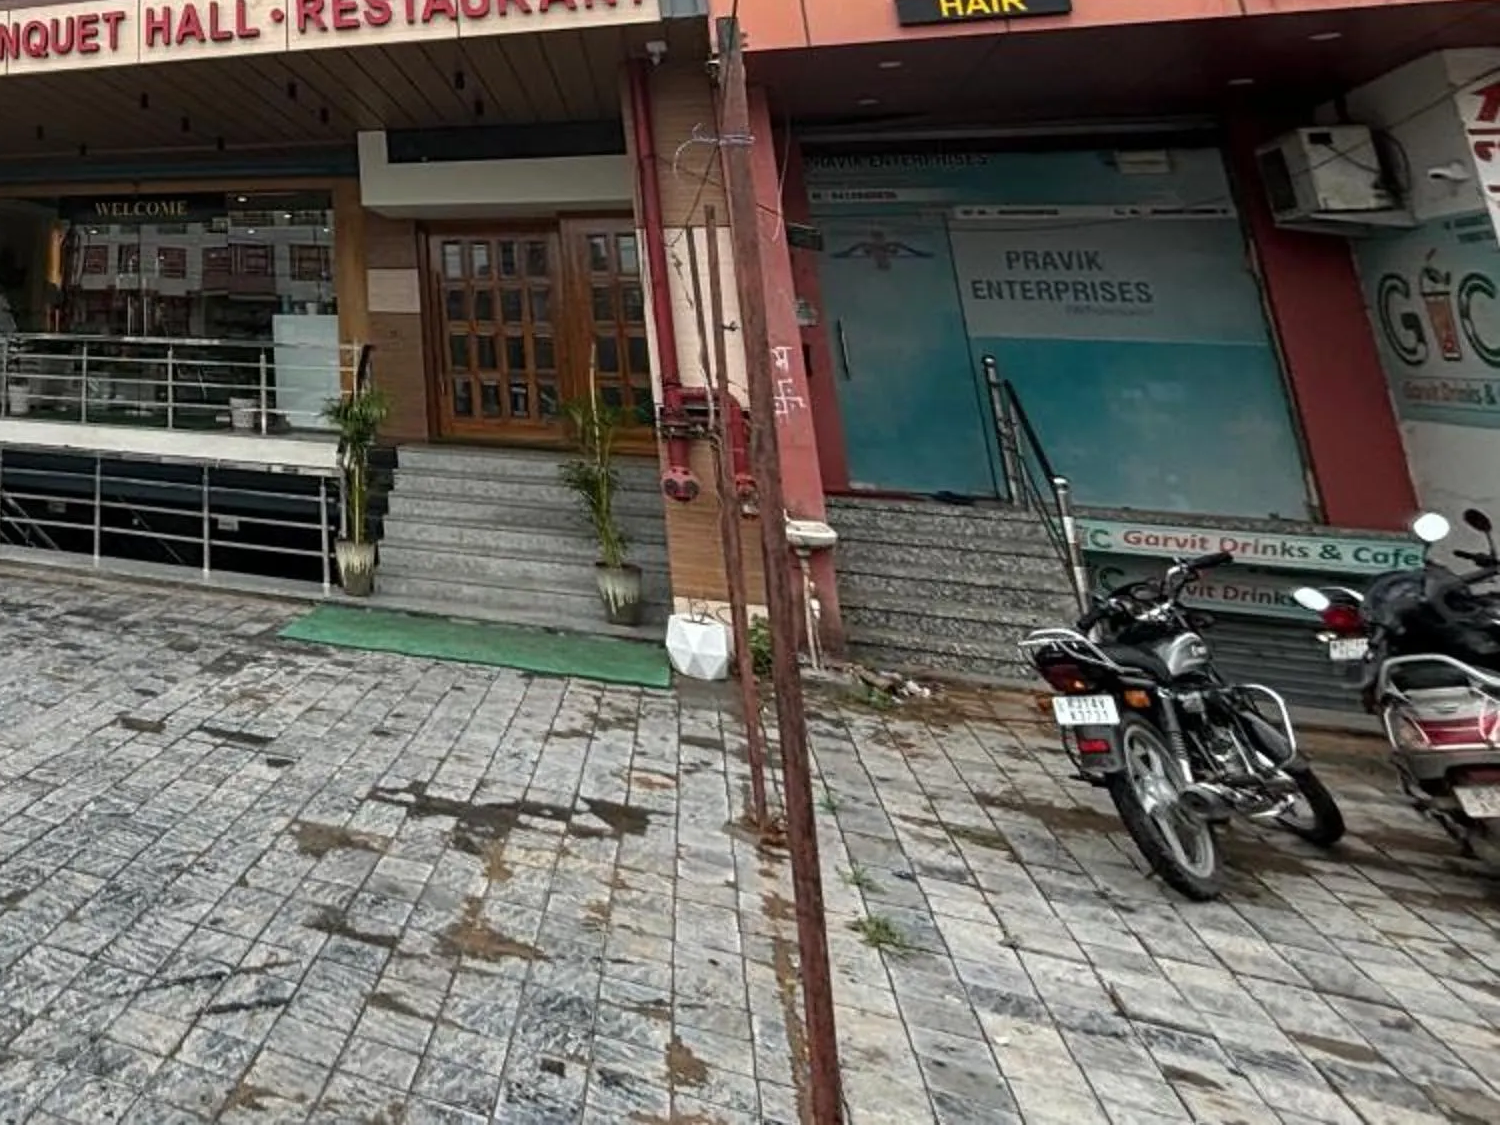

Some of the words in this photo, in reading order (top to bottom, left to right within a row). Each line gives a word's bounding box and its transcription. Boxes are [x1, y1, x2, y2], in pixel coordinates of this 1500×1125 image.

[94, 200, 188, 218] WELCOME
[1006, 250, 1103, 271] PRAVIK
[970, 279, 1154, 304] ENTERPRISES
[1123, 528, 1209, 553] Garvit
[1219, 536, 1310, 561] Drinks
[1319, 544, 1342, 562] &
[1353, 545, 1421, 571] Cafe
